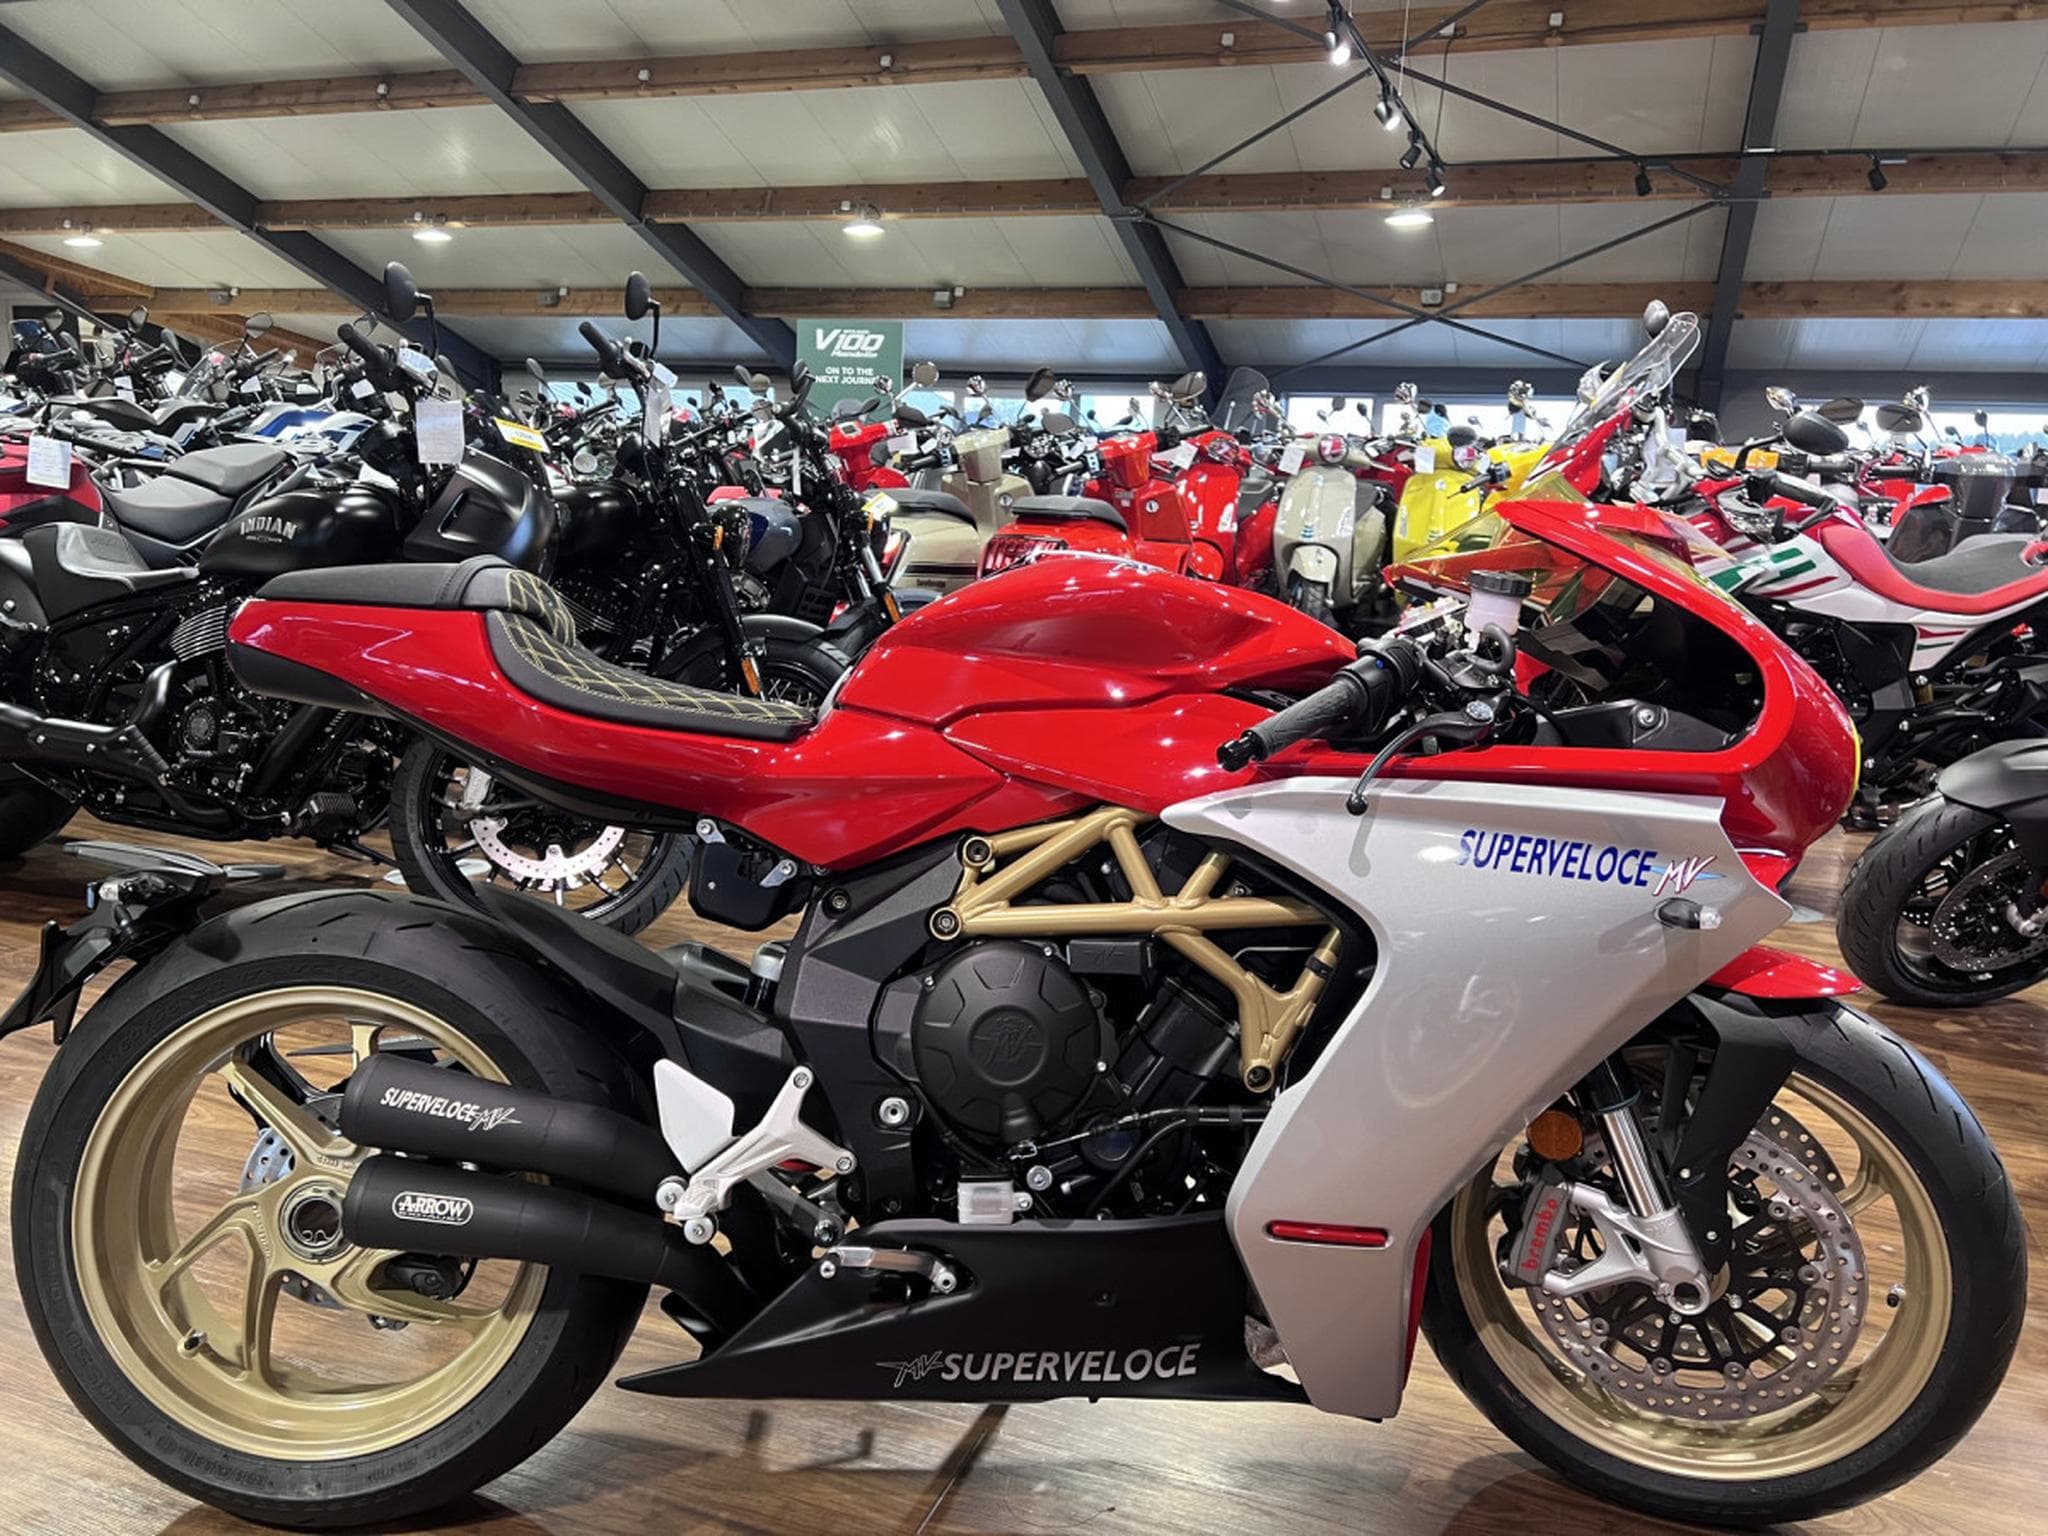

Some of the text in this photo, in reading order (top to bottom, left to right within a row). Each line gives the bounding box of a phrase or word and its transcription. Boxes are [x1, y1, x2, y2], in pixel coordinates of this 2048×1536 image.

[816, 328, 885, 351] V100
[815, 375, 839, 384] NEXT
[825, 366, 874, 376] ON TO THE
[240, 516, 298, 540] INDIAN
[1458, 829, 1657, 887] SUPERVELOCE
[380, 1087, 480, 1122] SUPERVELOCE
[399, 1195, 468, 1217] ARROW
[1520, 1199, 1558, 1270] brembo
[941, 1343, 1201, 1381] SUPERVELOCE
